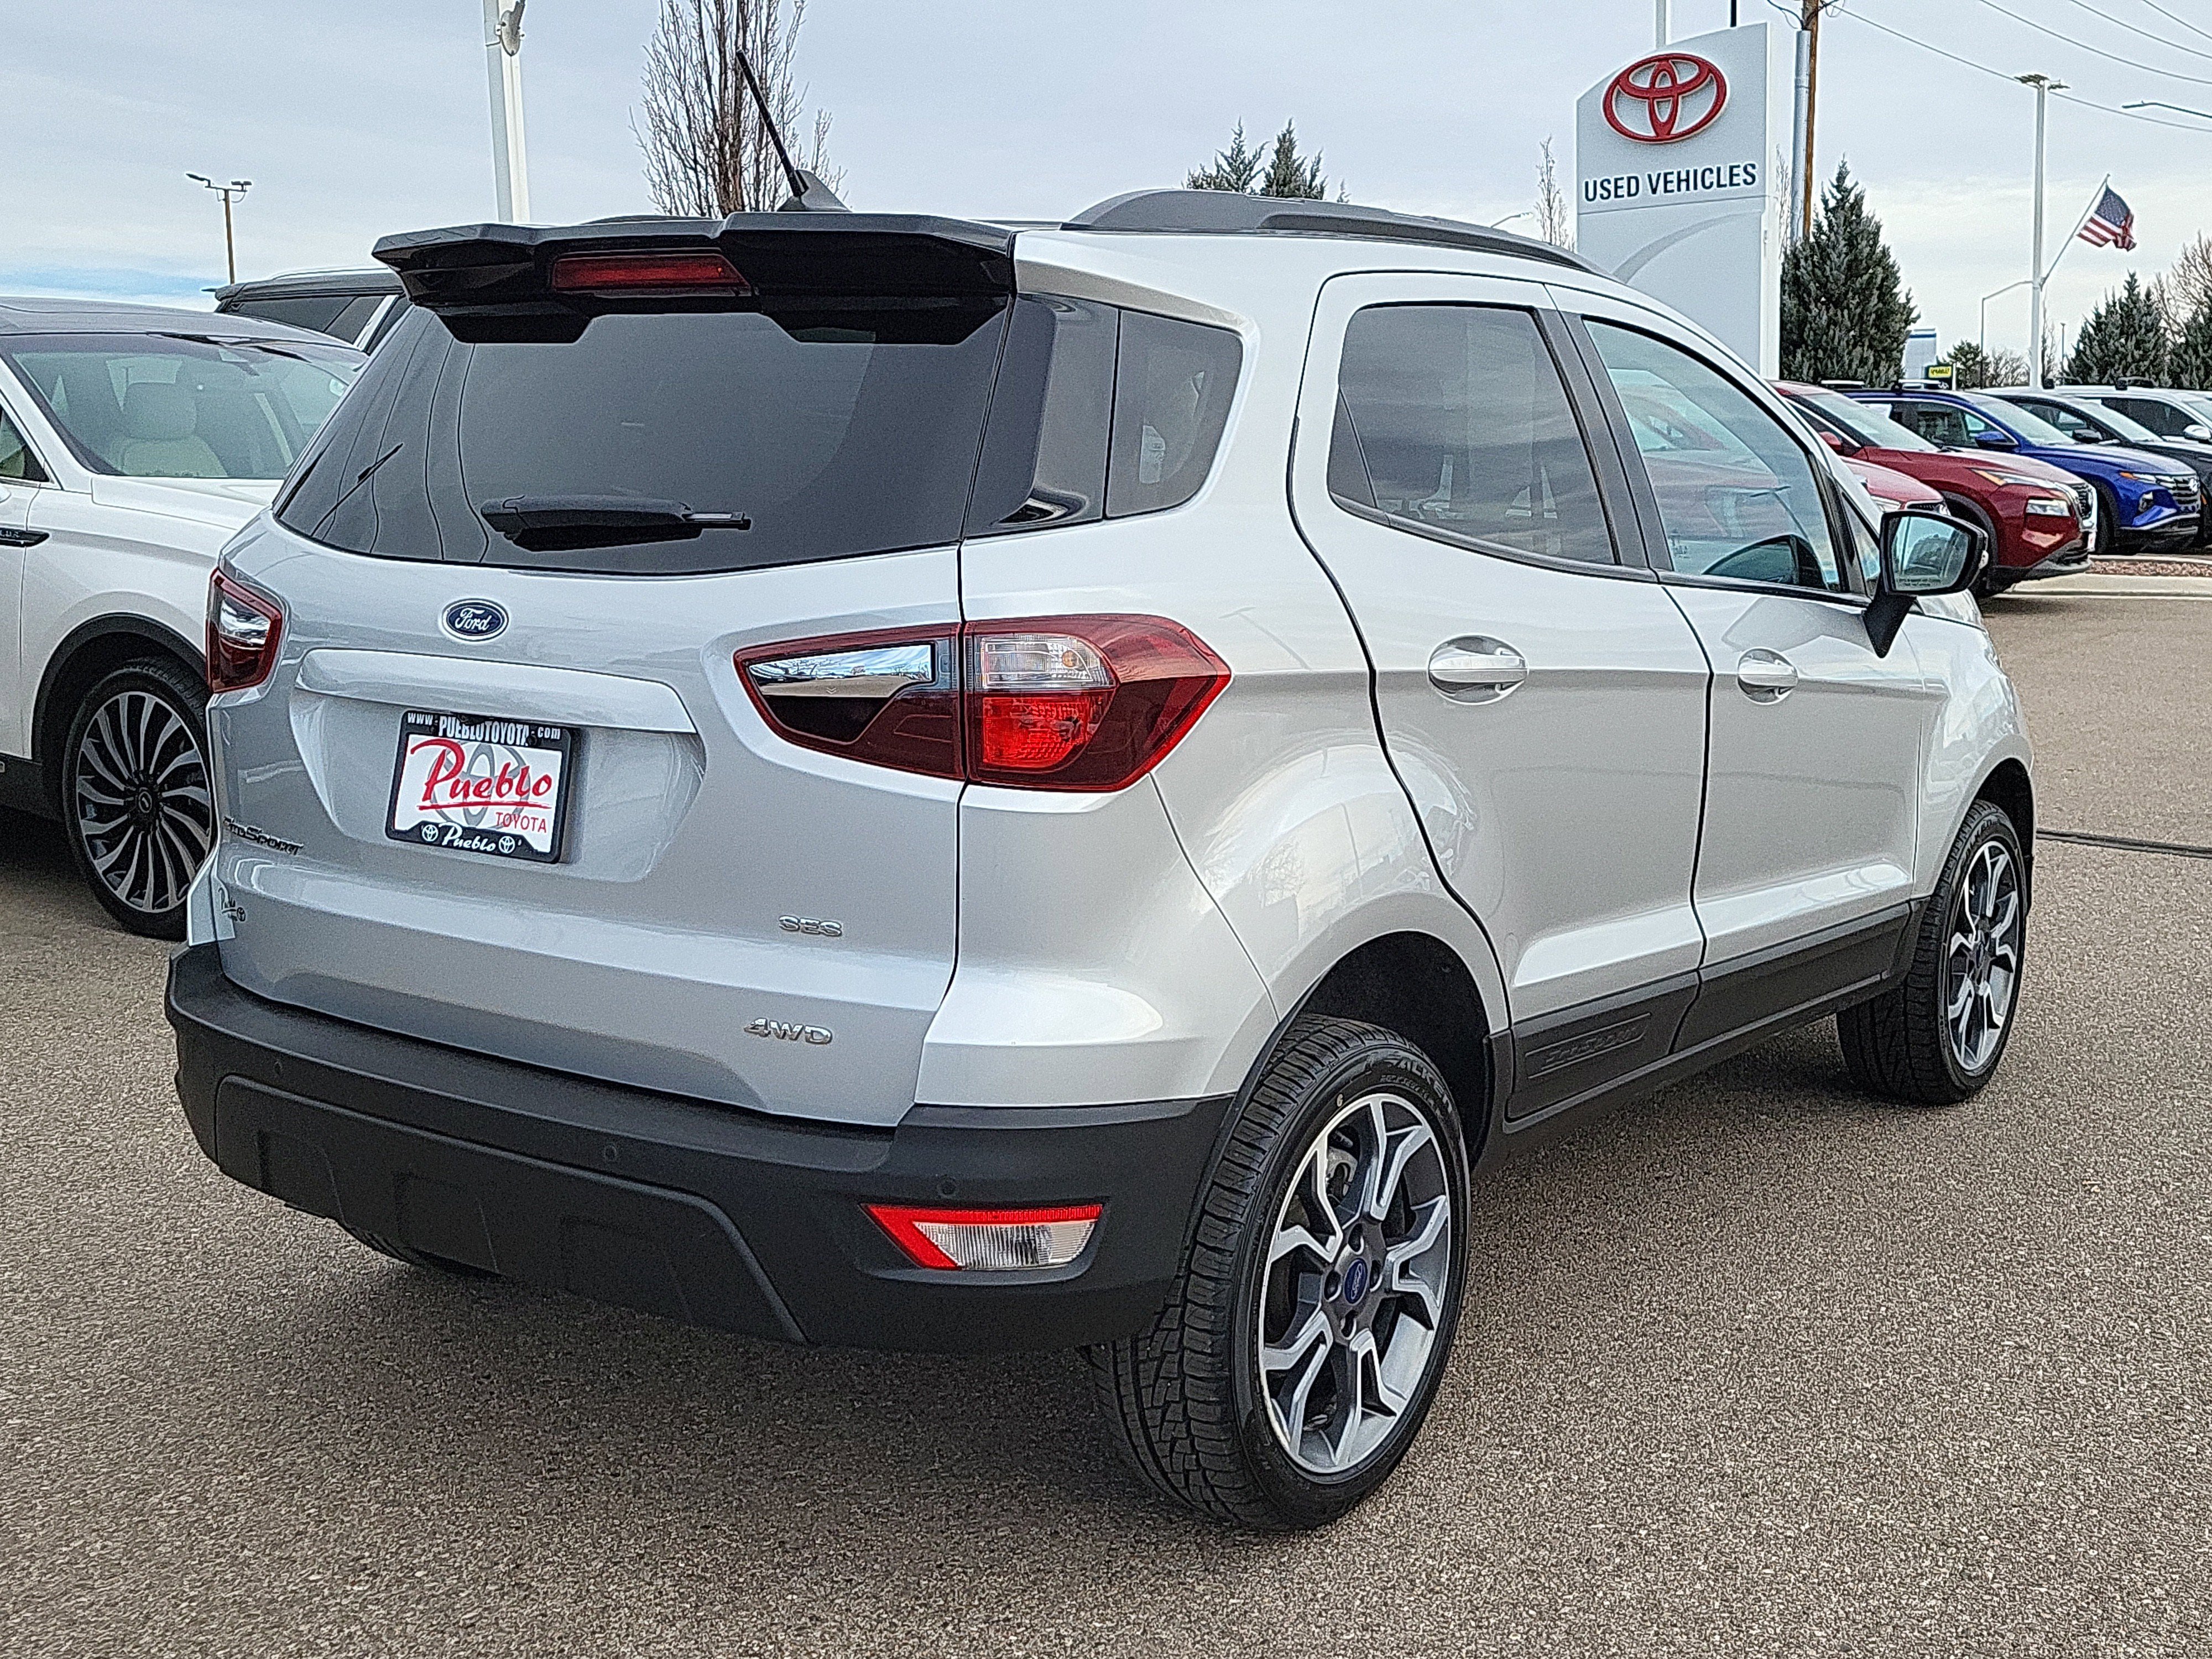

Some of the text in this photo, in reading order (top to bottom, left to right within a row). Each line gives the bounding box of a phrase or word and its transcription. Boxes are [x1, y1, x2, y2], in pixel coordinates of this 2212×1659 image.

[1584, 164, 1756, 201] USED VEHICLES
[455, 608, 492, 630] Ford
[410, 737, 552, 802] Pueblo
[495, 812, 547, 833] TOYOTA
[439, 822, 496, 852] Pueblo
[779, 915, 842, 937] SES
[744, 1018, 833, 1045] 4WD
